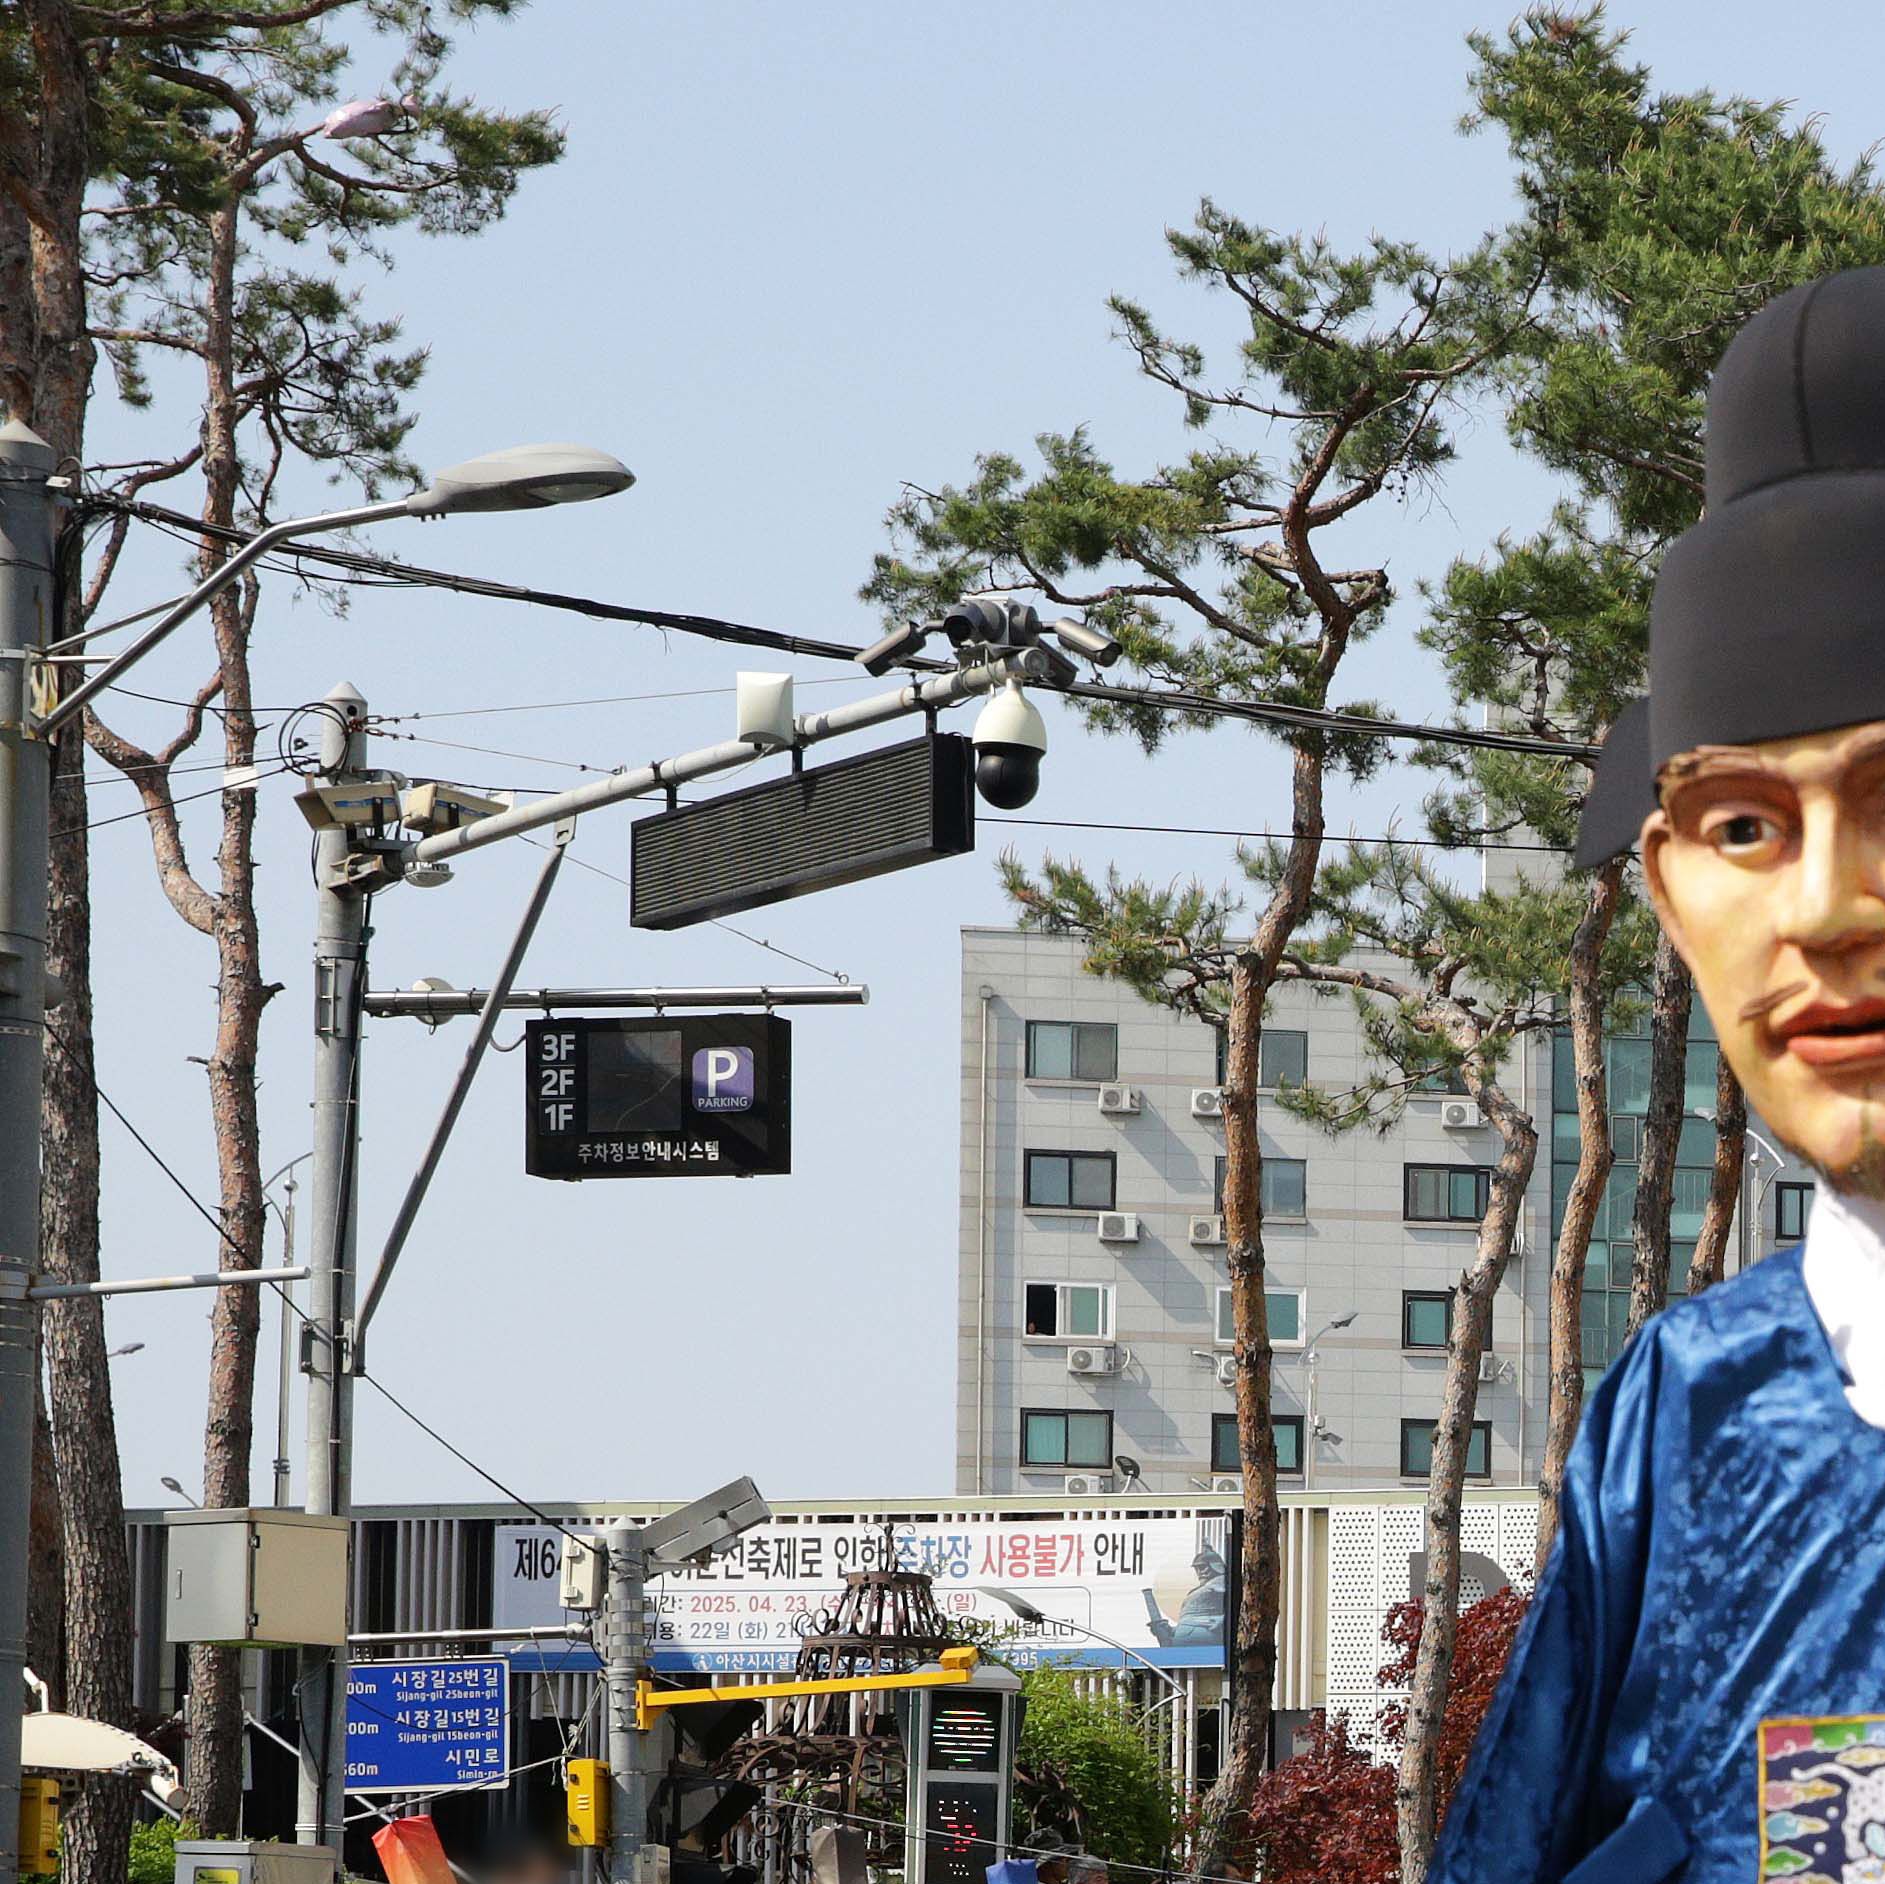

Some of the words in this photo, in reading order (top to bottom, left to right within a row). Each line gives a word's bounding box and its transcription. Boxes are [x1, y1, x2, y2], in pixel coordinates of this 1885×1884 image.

[542, 1034, 575, 1061] 3F
[541, 1069, 575, 1096] 2F
[708, 1050, 739, 1097] P
[698, 1097, 748, 1108] PARKING
[544, 1104, 574, 1131] 1F
[578, 1141, 720, 1164] 주차정보안내시스템
[514, 1538, 560, 1580] 제6
[980, 1534, 1084, 1578] 사용불가
[1094, 1532, 1144, 1576] 안내
[691, 1596, 740, 1613] 2025.
[749, 1596, 776, 1613] 04.
[785, 1596, 812, 1613] 23.
[947, 1593, 976, 1613] (일)
[690, 1622, 730, 1640] 22일
[738, 1621, 768, 1640] (화)
[346, 1722, 379, 1735] 00m
[445, 1748, 500, 1767] 시민로
